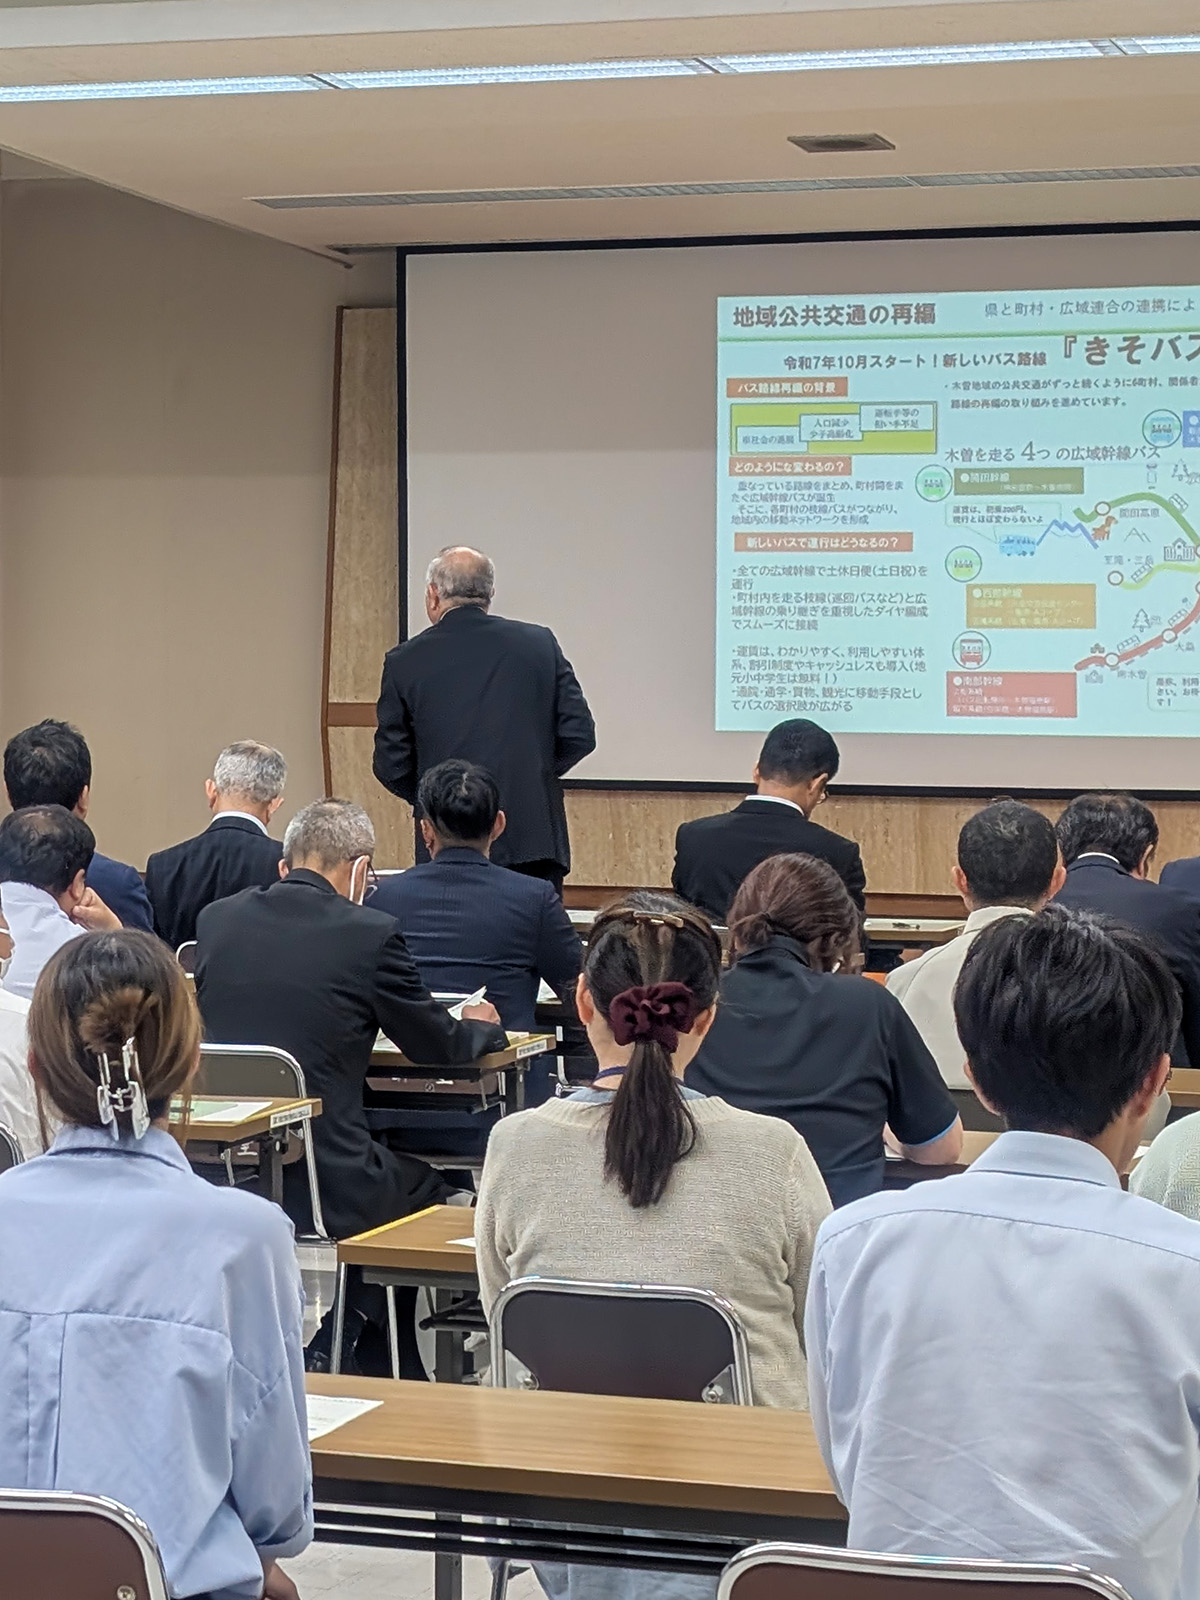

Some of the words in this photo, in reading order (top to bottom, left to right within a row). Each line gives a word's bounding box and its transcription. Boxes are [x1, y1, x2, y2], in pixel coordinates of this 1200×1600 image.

[985, 298, 1196, 318] 県と町村・広域連合の連携によ
[733, 303, 936, 328] 地域公共交通の再編
[737, 381, 836, 394] バス路線再編の背景
[747, 536, 899, 549] 新しいバスで運行はどうなるの？
[731, 578, 754, 590] 運行
[732, 619, 819, 631] でスムーズに接続
